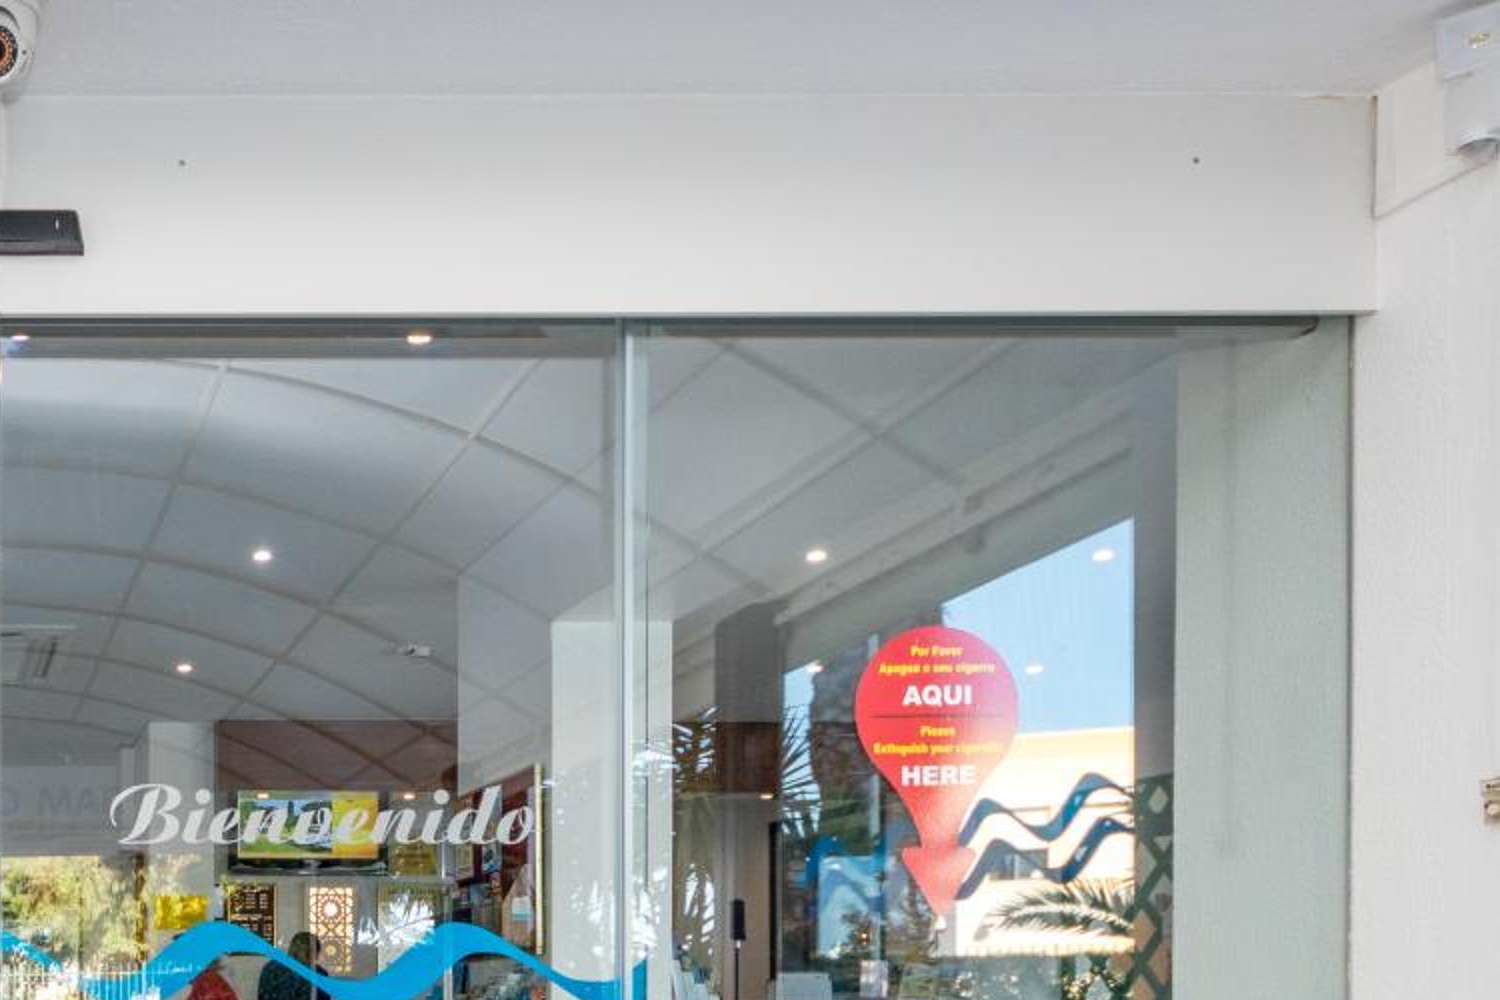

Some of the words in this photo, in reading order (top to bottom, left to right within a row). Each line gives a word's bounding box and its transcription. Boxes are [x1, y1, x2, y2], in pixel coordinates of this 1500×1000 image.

[910, 645, 929, 657] Por
[902, 684, 973, 706] AQUI
[901, 764, 976, 787] HERE
[108, 783, 536, 845] Bienvenido
